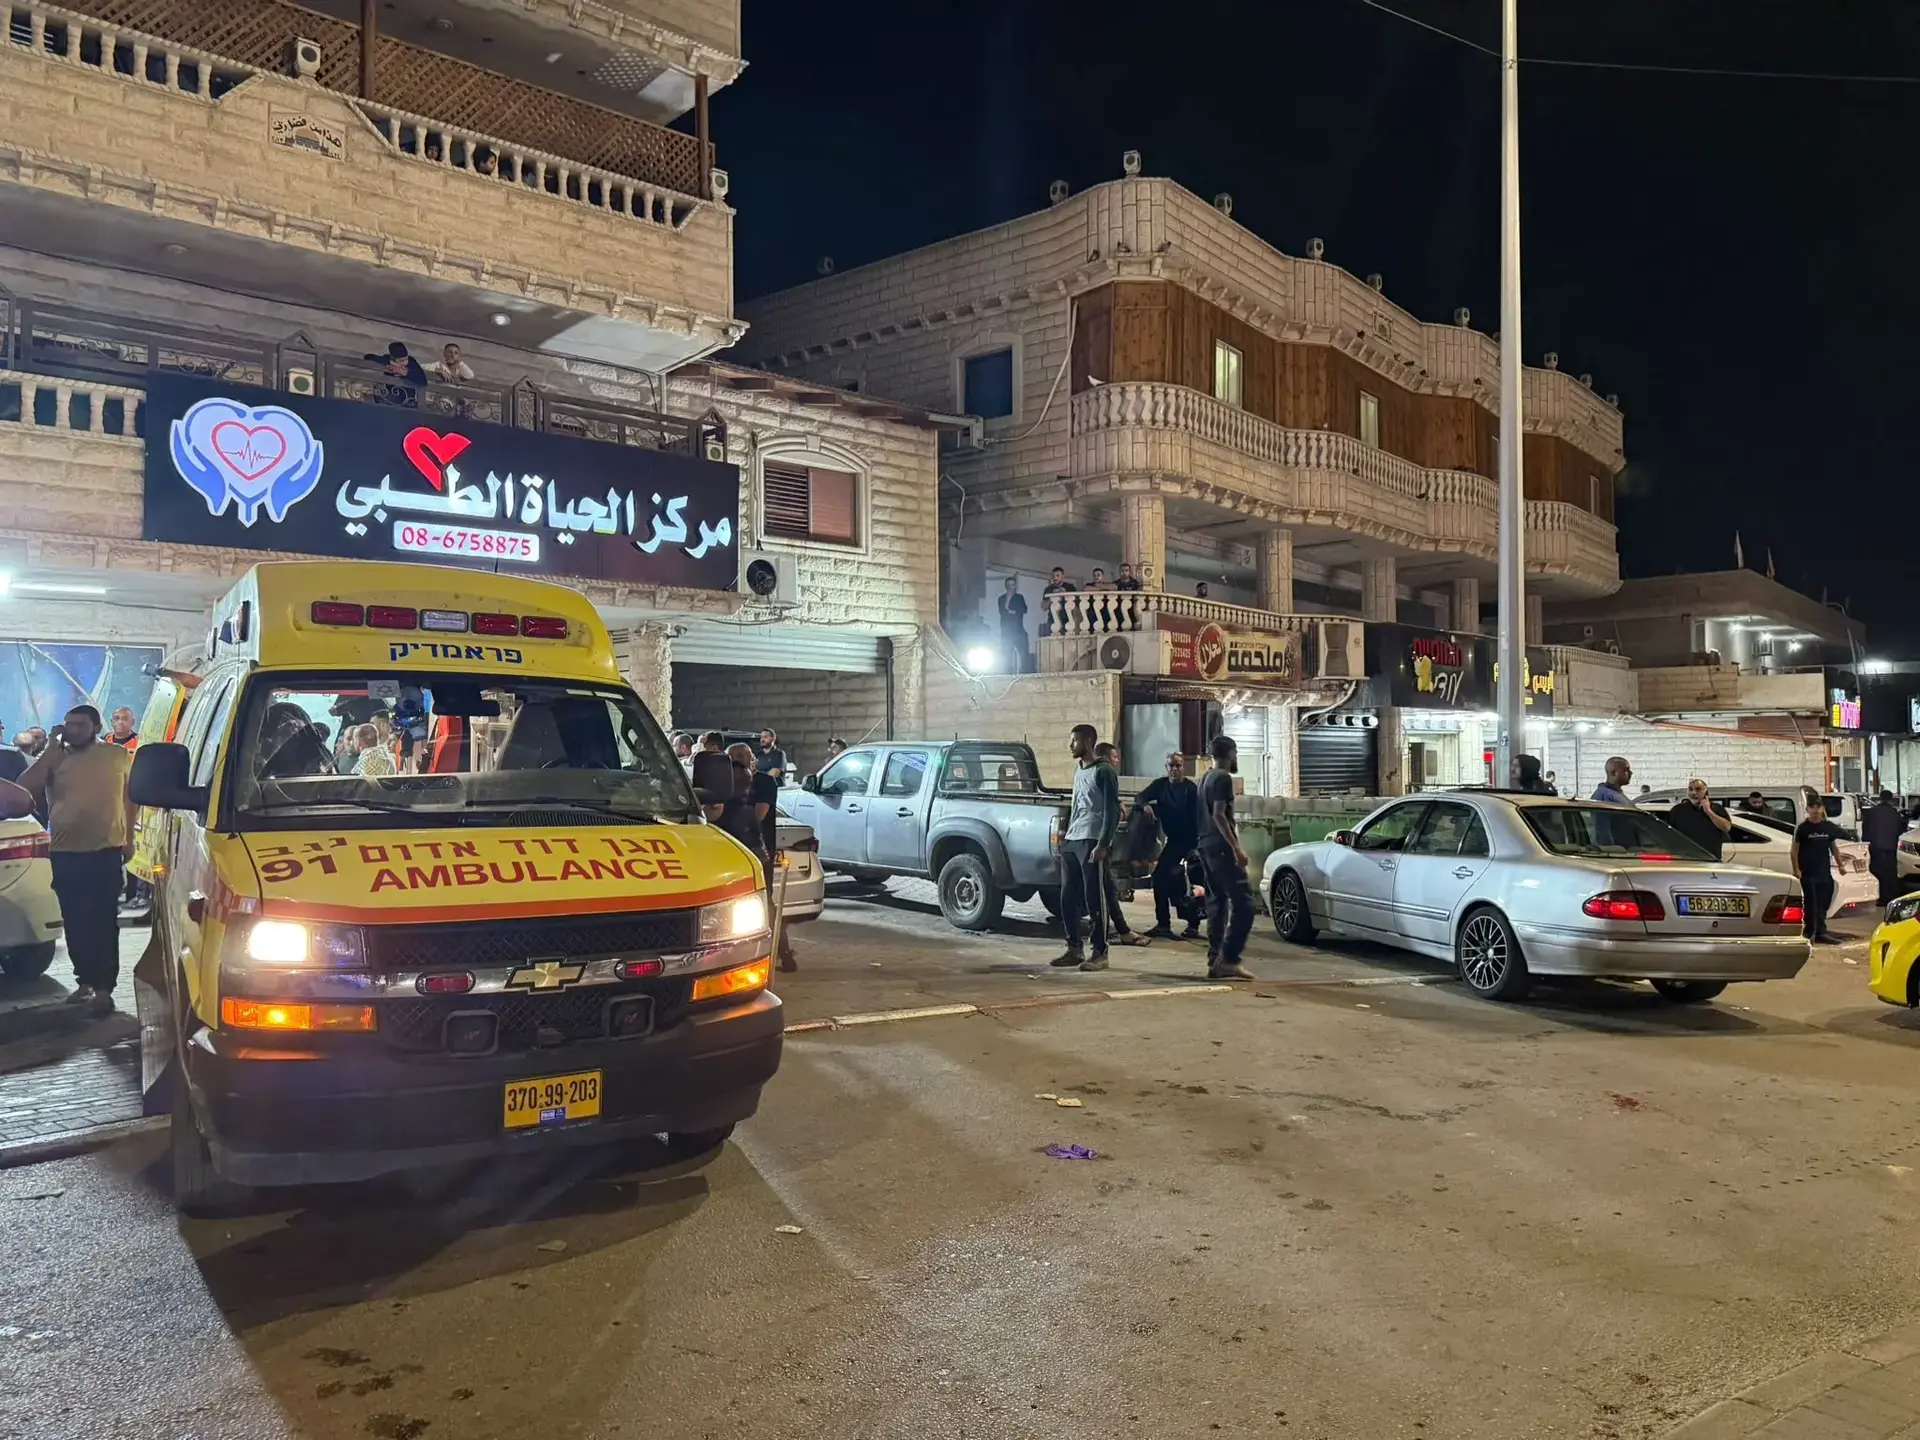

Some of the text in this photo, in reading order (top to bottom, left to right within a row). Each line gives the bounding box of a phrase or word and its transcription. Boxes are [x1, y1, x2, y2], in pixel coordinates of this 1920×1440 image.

[336, 463, 732, 559] مركز الحياة الطبي
[402, 526, 532, 556] 08-6758875
[389, 642, 523, 664] פראמדיק
[358, 838, 676, 863] מגן דוד אדום
[261, 854, 338, 883] 91
[370, 858, 690, 893] AMBULANCE
